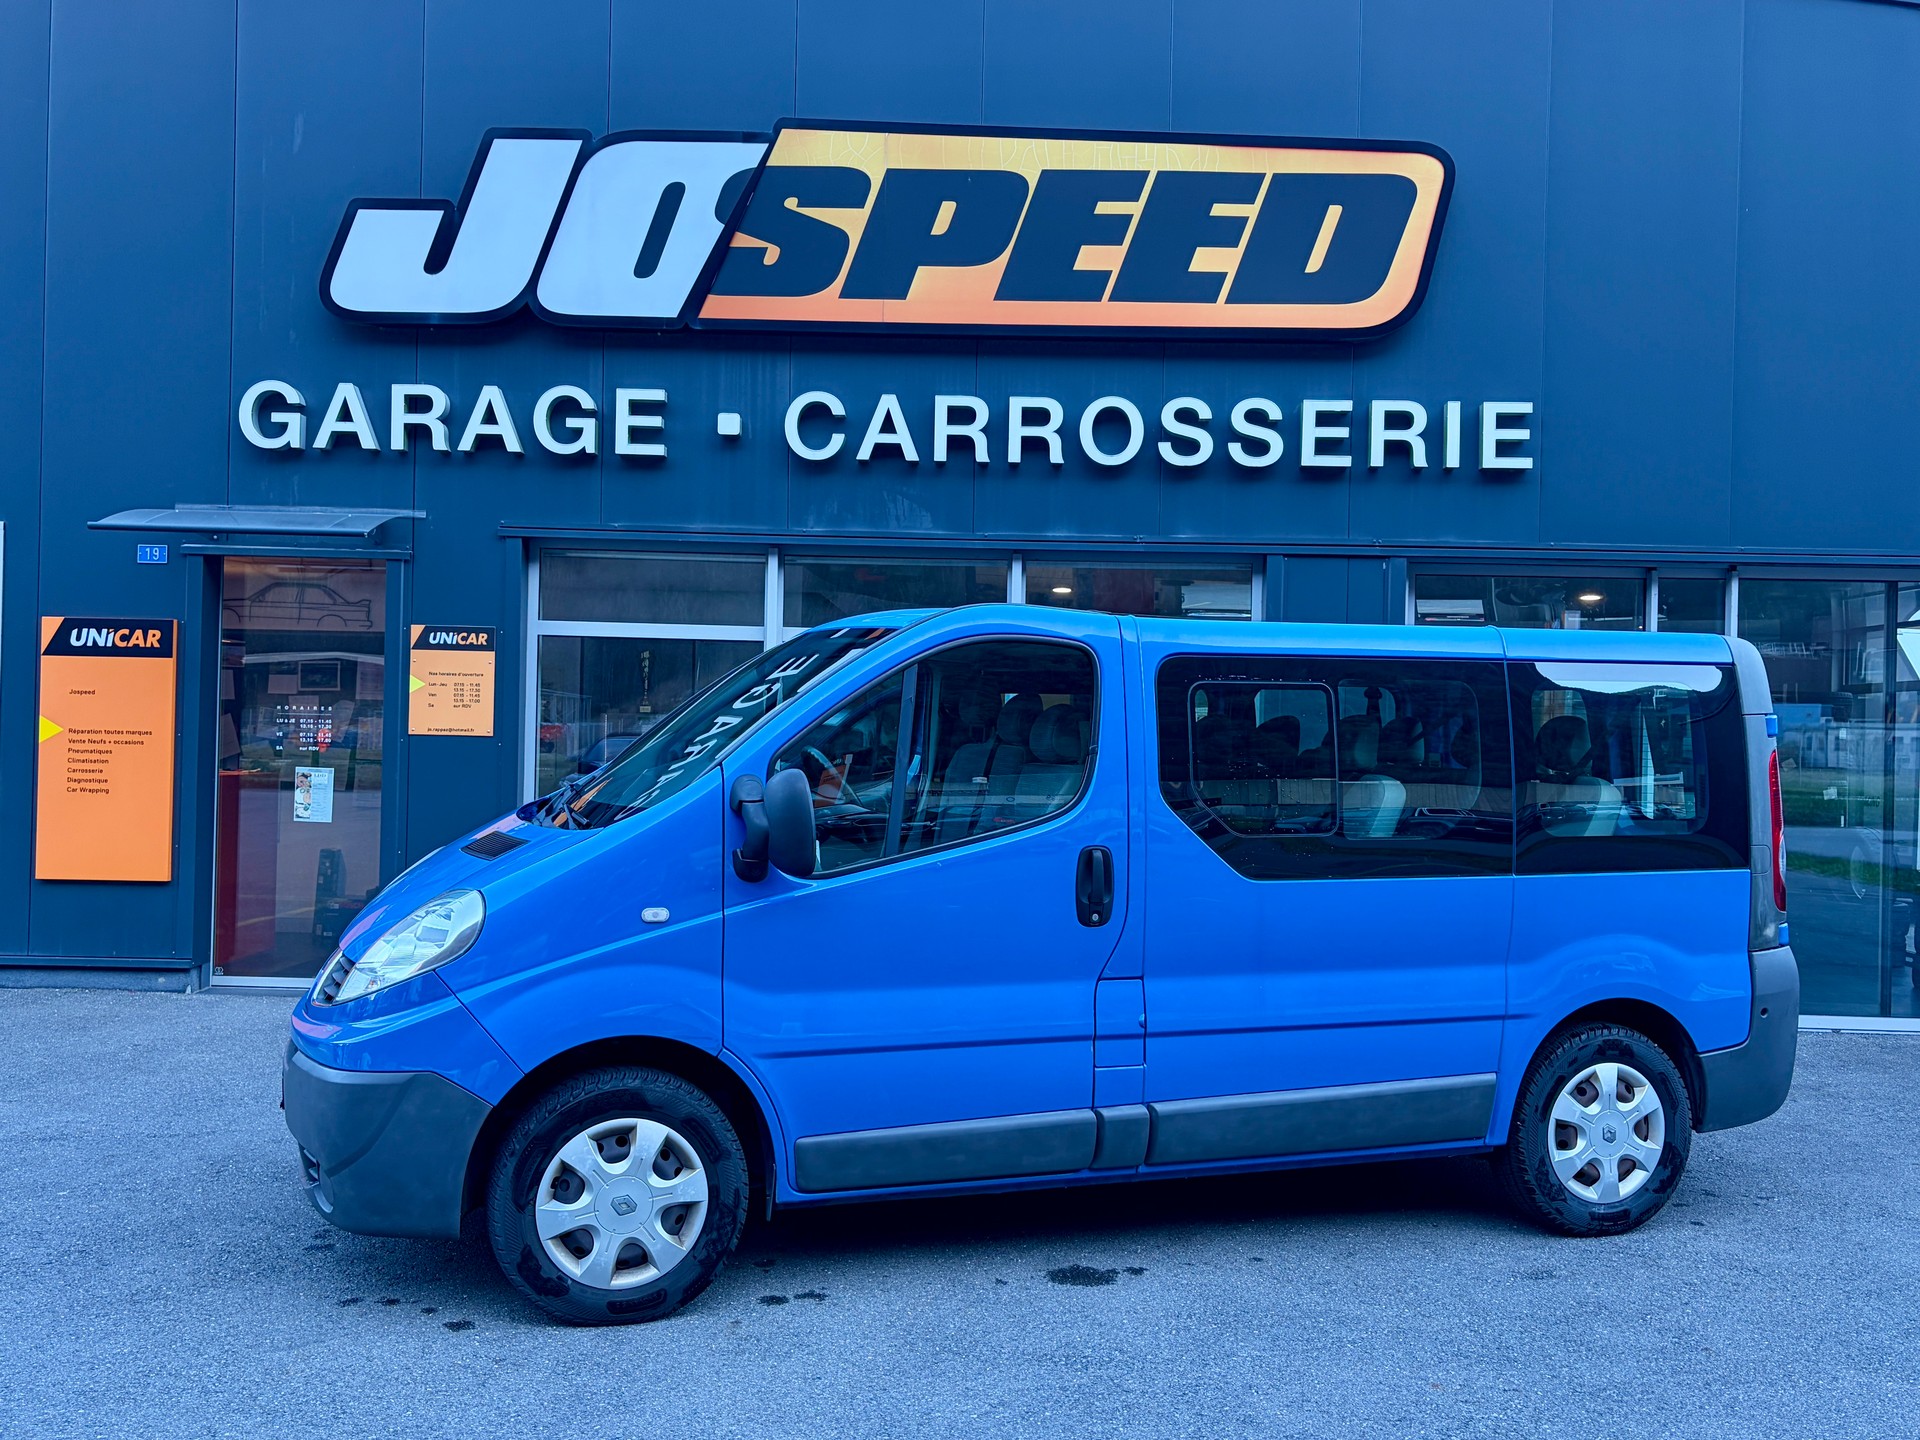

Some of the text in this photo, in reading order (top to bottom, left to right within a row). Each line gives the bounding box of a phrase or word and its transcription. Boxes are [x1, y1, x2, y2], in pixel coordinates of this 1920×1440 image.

[329, 136, 1418, 318] JOSPEED
[238, 379, 669, 458] GARAGE
[783, 390, 1534, 471] CARROSSERIE
[145, 547, 160, 561] 19
[68, 747, 112, 755] Pneumatiques
